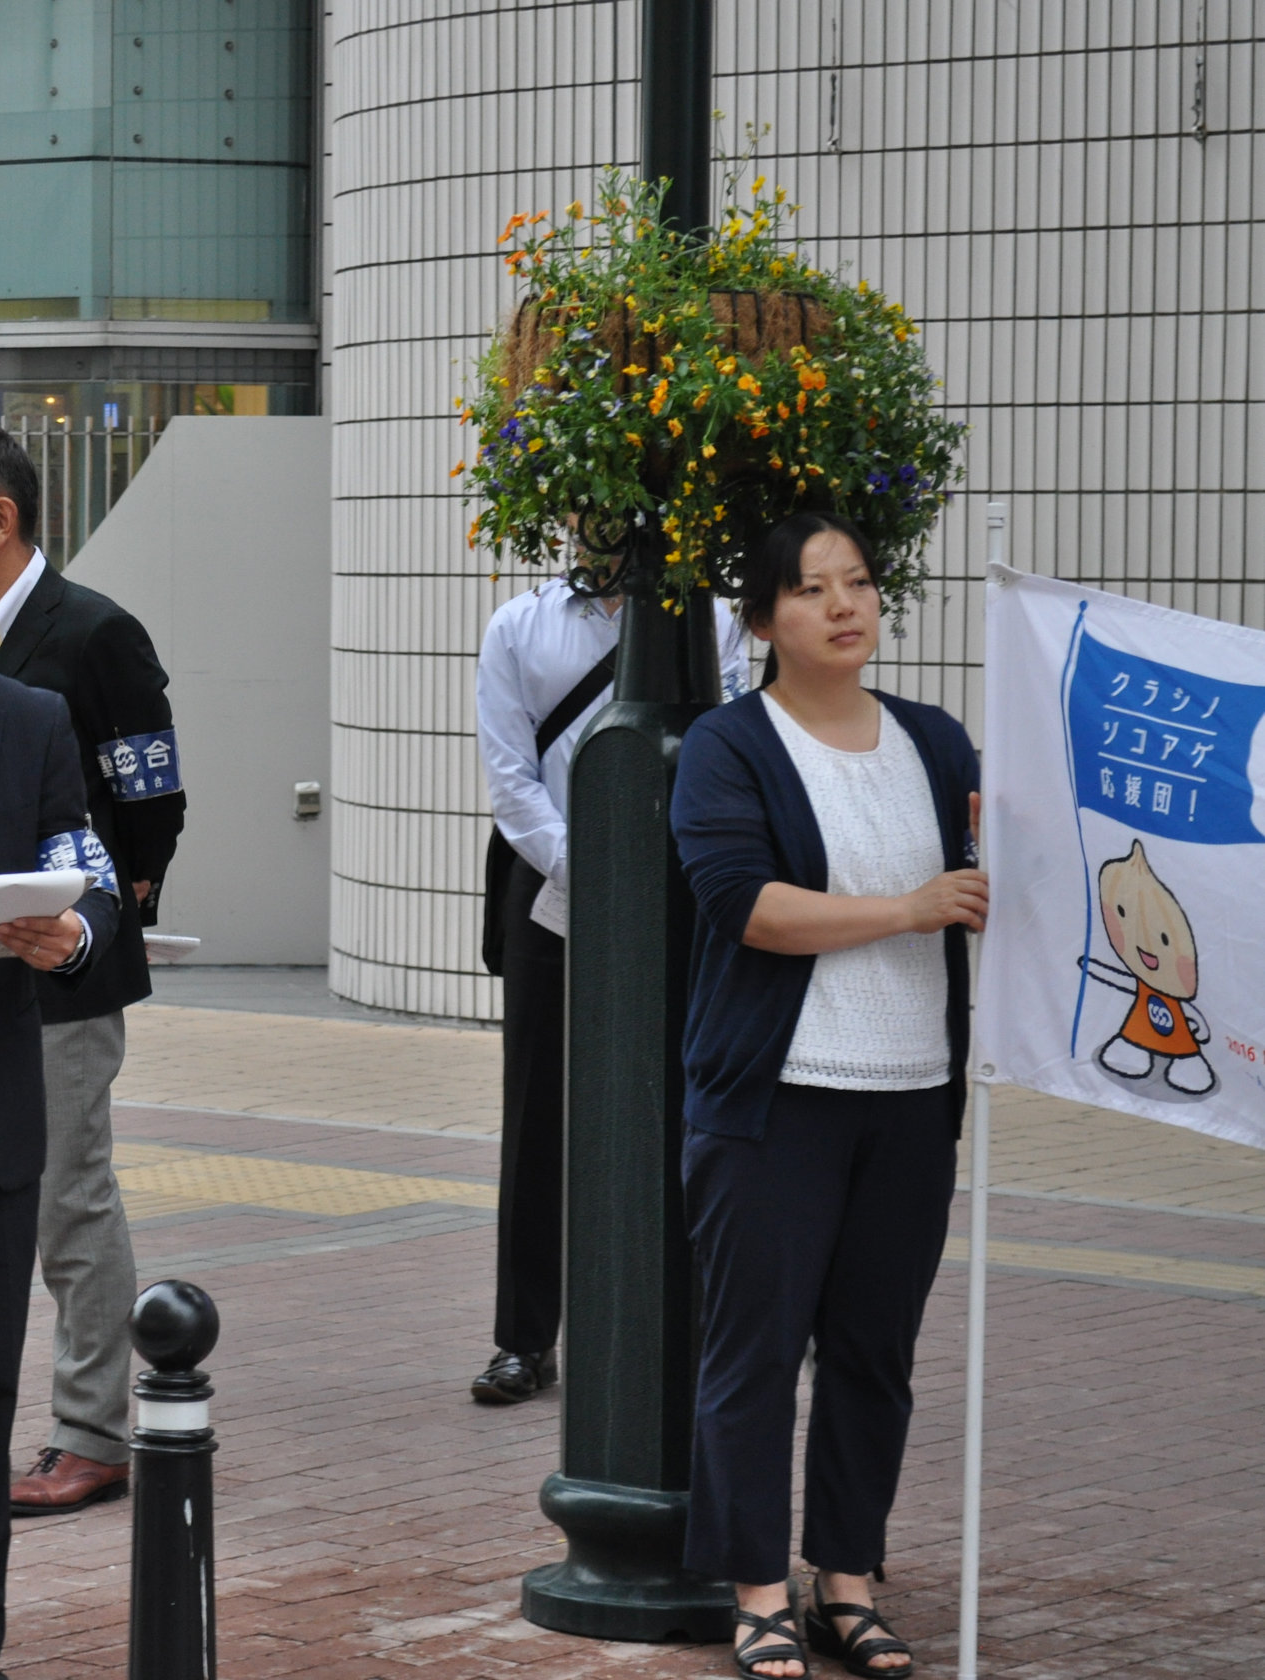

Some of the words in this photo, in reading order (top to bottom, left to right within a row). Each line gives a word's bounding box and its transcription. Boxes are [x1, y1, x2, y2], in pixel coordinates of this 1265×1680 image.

[1111, 672, 1220, 719] クラシノ
[1102, 721, 1215, 769] ソコアゲ
